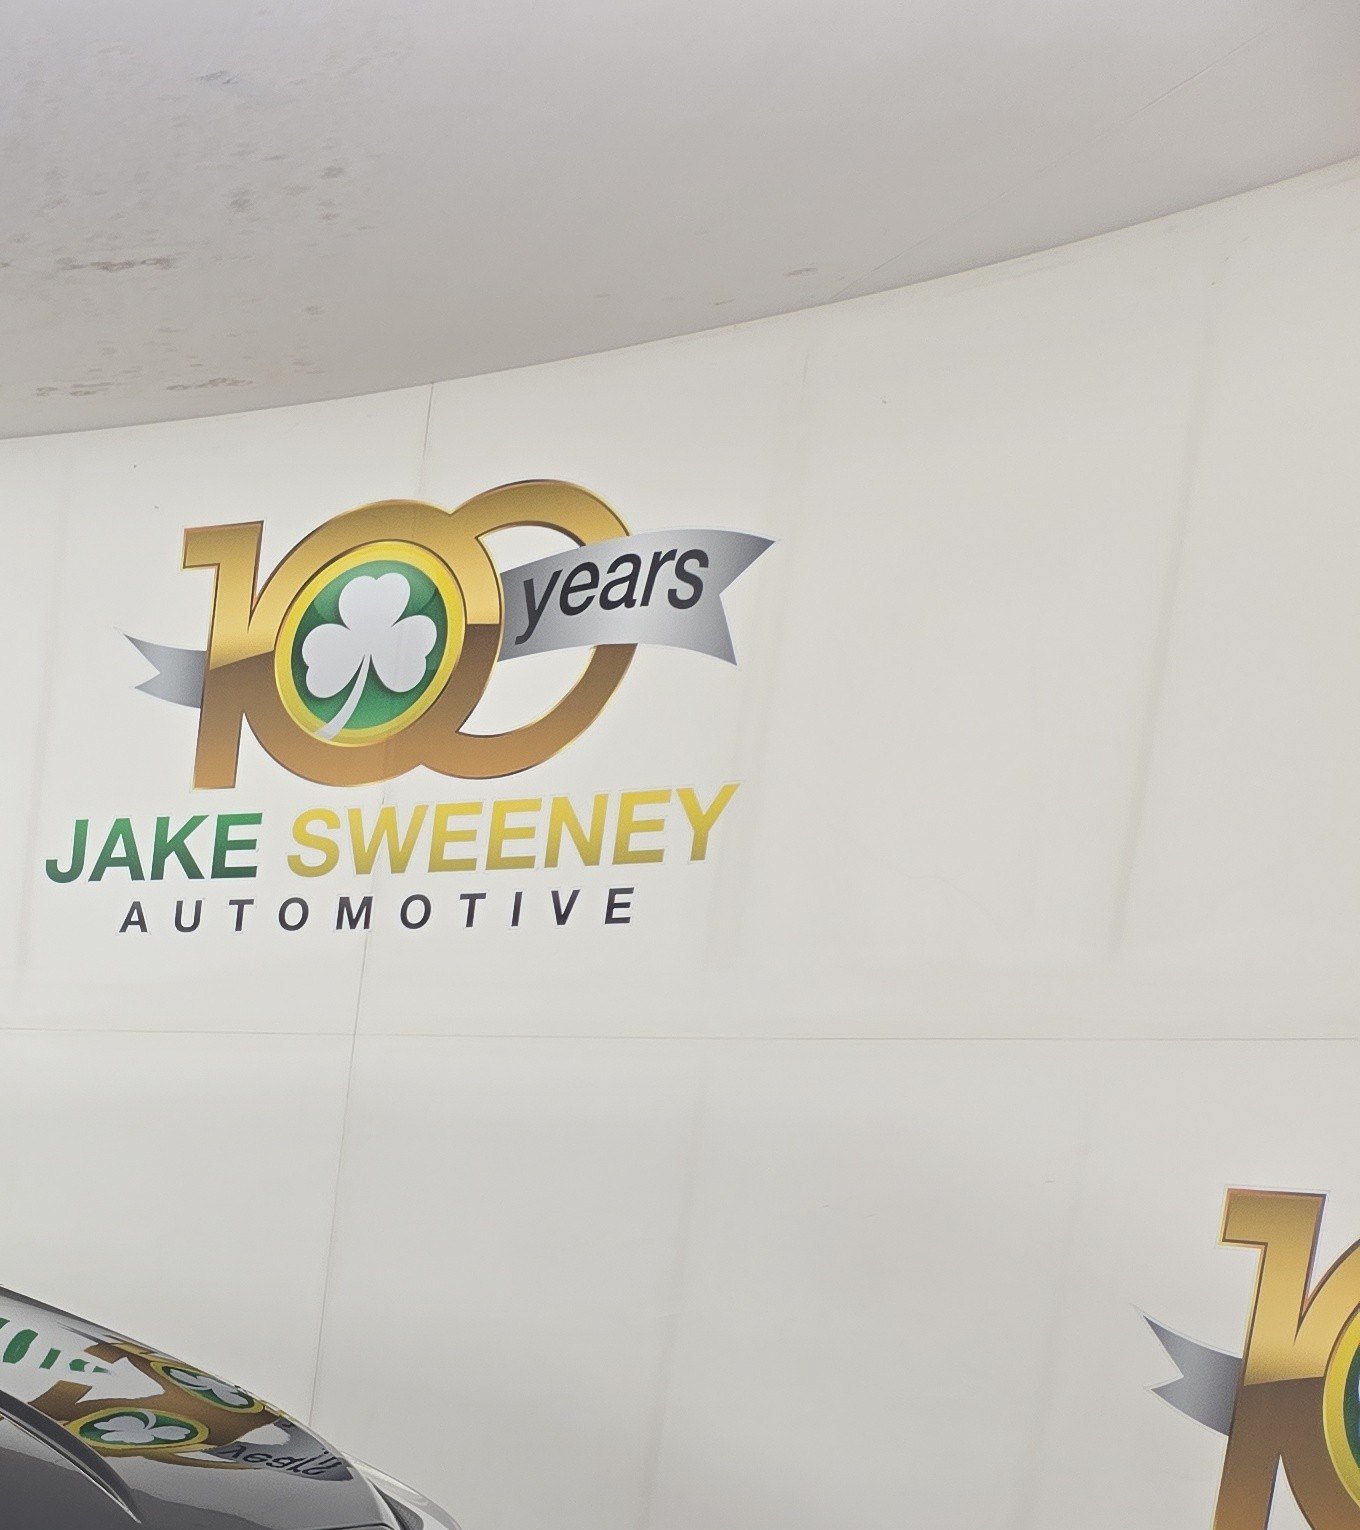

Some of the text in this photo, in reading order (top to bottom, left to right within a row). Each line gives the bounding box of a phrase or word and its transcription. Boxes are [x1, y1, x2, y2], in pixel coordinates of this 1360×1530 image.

[181, 478, 710, 791] 100 years
[45, 783, 740, 883] JAKE SWEENEY
[119, 886, 635, 934] AUTOMOTIVE
